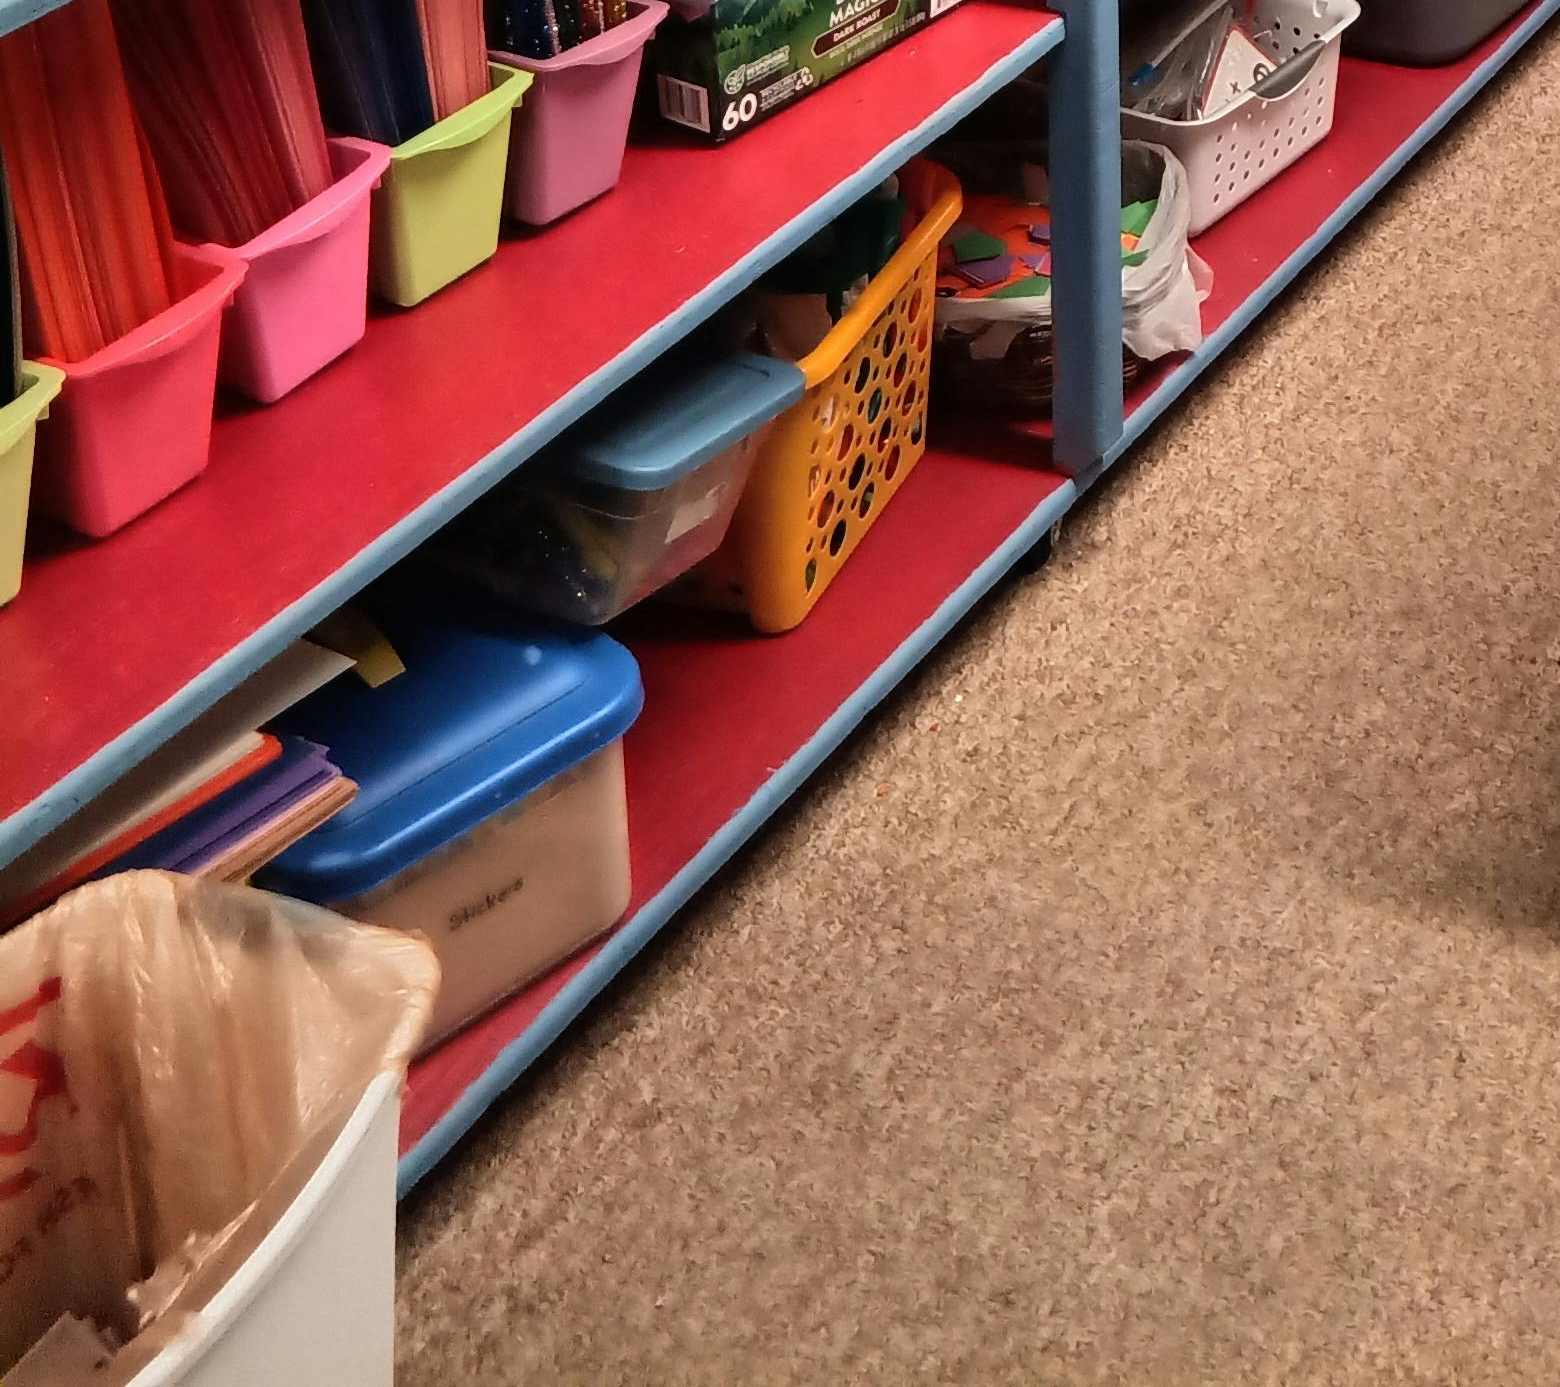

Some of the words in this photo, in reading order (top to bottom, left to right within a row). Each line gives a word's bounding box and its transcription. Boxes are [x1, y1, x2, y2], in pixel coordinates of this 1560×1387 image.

[834, 22, 855, 42] DARK
[855, 9, 881, 32] ROAST
[723, 92, 758, 131] 60
[449, 877, 523, 931] Stickers
